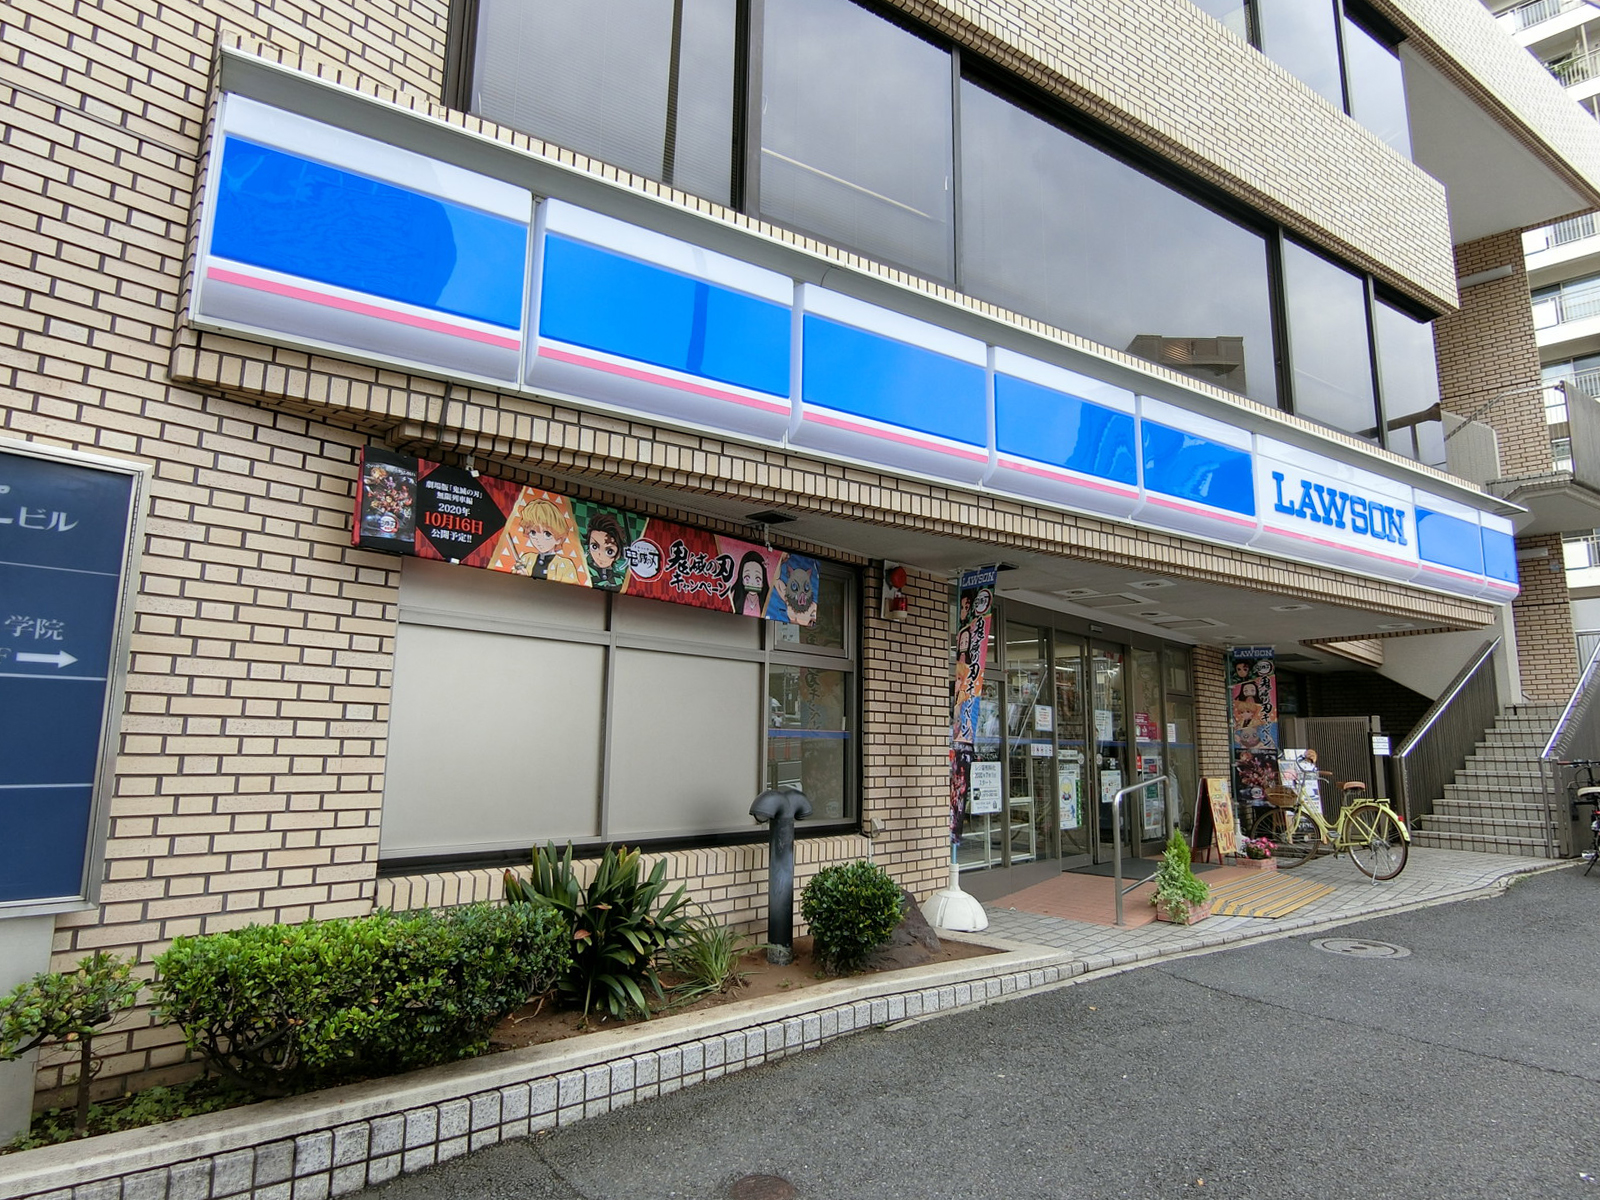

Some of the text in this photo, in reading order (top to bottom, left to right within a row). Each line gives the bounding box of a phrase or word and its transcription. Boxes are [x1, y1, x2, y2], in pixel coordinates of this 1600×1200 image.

[438, 502, 471, 517] 2020年
[1272, 470, 1408, 546] LAWSON
[424, 511, 484, 535] 10月16日
[665, 539, 735, 585] 鬼滅の刃
[669, 572, 733, 599] キャンペーン
[962, 571, 995, 587] LAWSON
[4, 614, 66, 641] 学院
[1233, 649, 1274, 658] LAWSON
